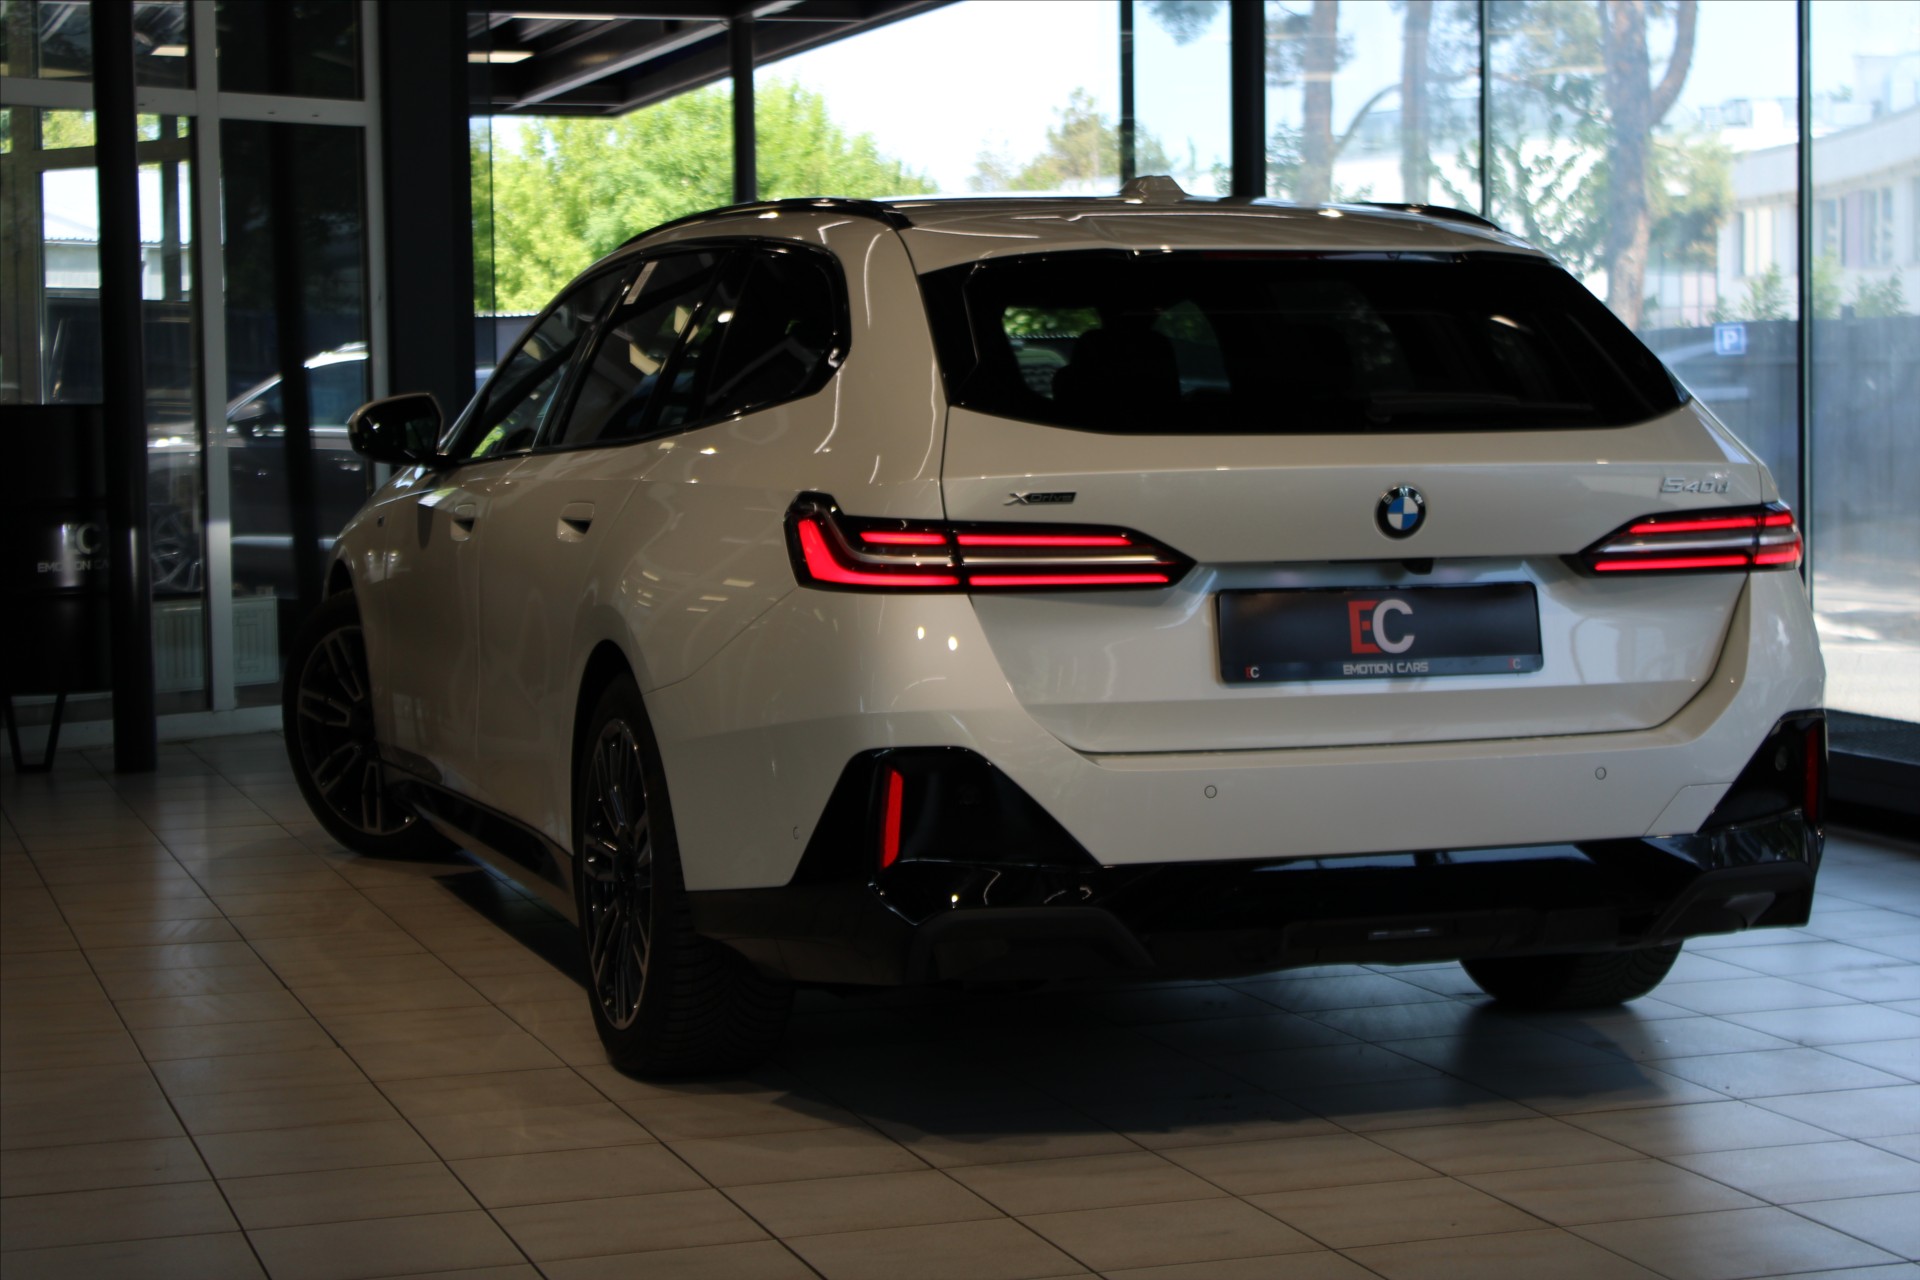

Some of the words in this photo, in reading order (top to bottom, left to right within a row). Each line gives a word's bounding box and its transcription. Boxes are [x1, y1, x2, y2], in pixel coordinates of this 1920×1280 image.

[1382, 486, 1423, 505] BMW
[1348, 599, 1415, 654] EC
[1343, 662, 1393, 676] EMOTION
[1396, 661, 1429, 674] CARS
